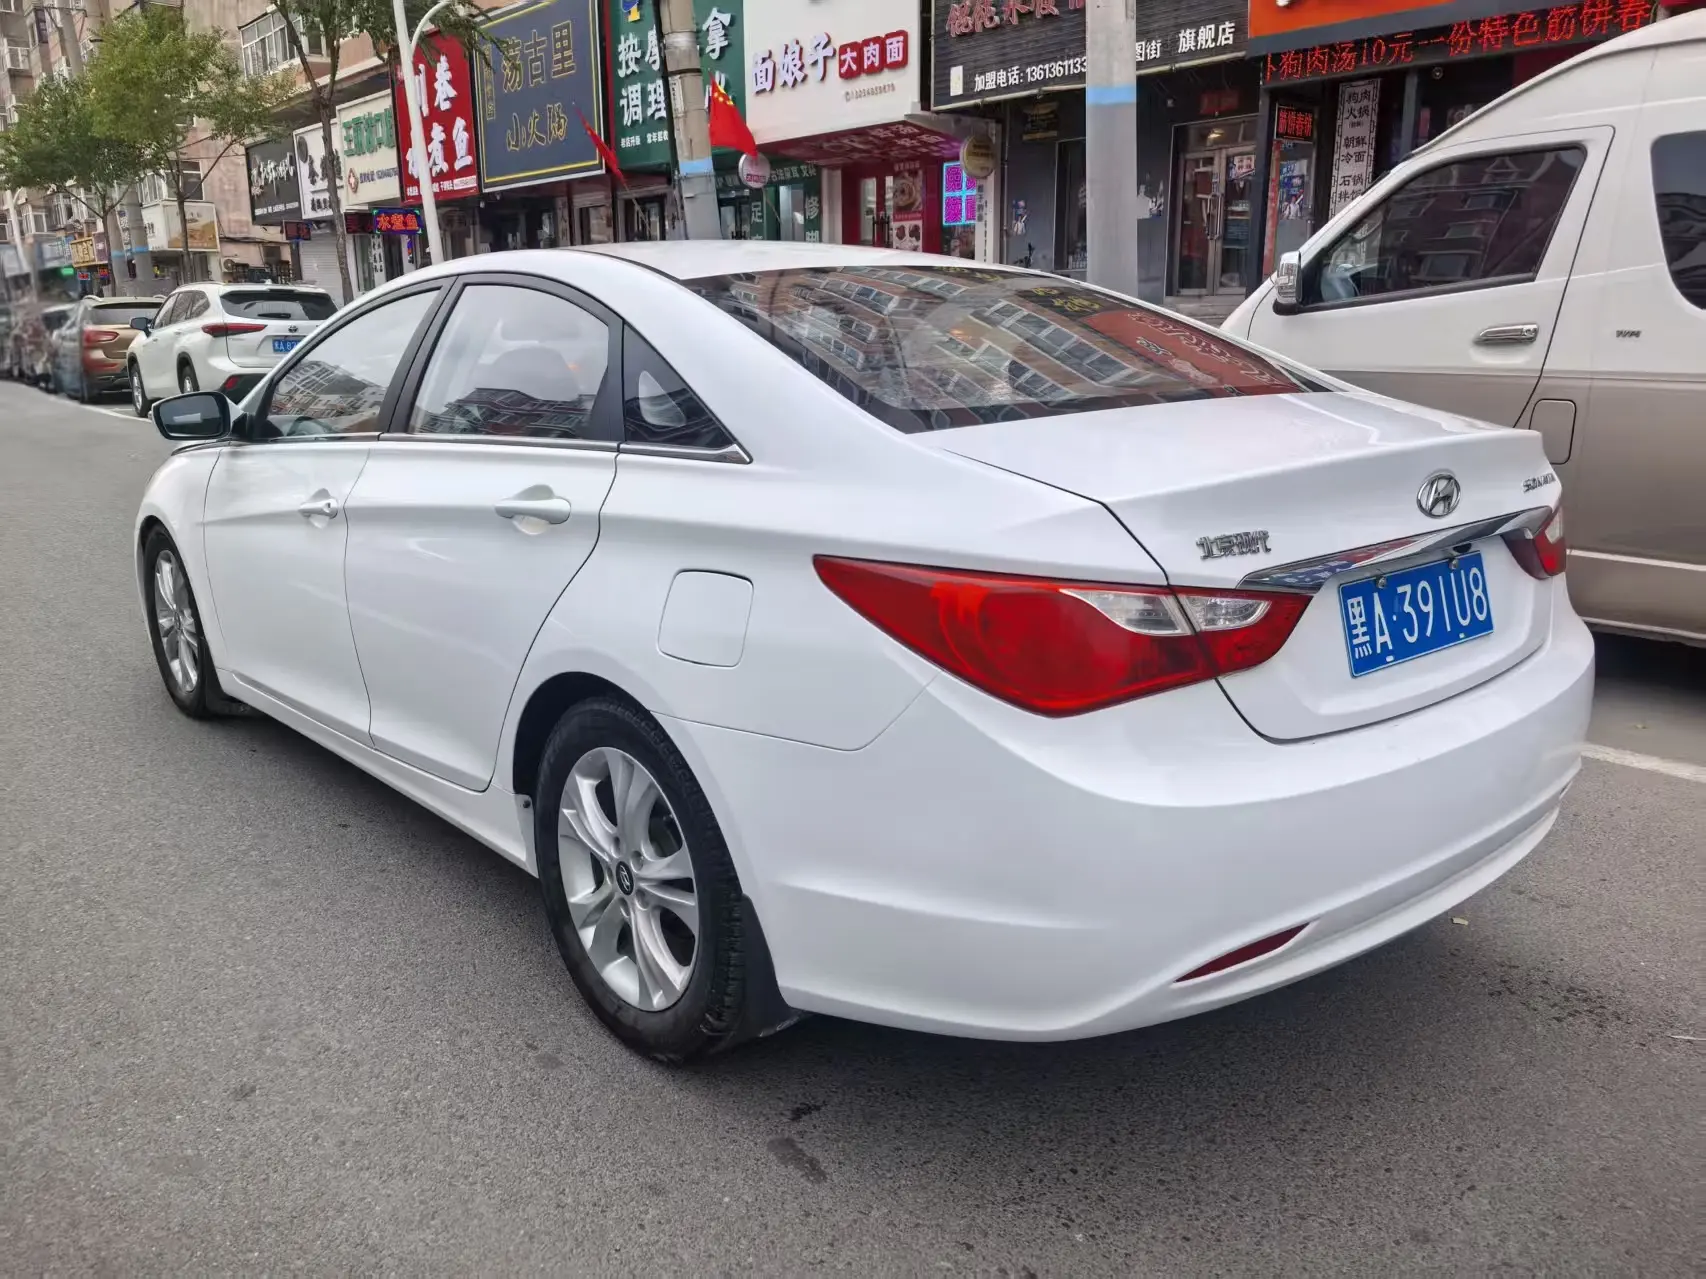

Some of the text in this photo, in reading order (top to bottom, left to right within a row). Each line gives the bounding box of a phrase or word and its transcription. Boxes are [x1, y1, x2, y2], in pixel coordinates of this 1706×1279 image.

[1178, 21, 1235, 53] 旗舰店
[752, 33, 835, 94] 面娘子
[840, 35, 904, 74] 大肉面
[974, 66, 1023, 92] 加盟电话:
[1341, 151, 1366, 163] 冷面
